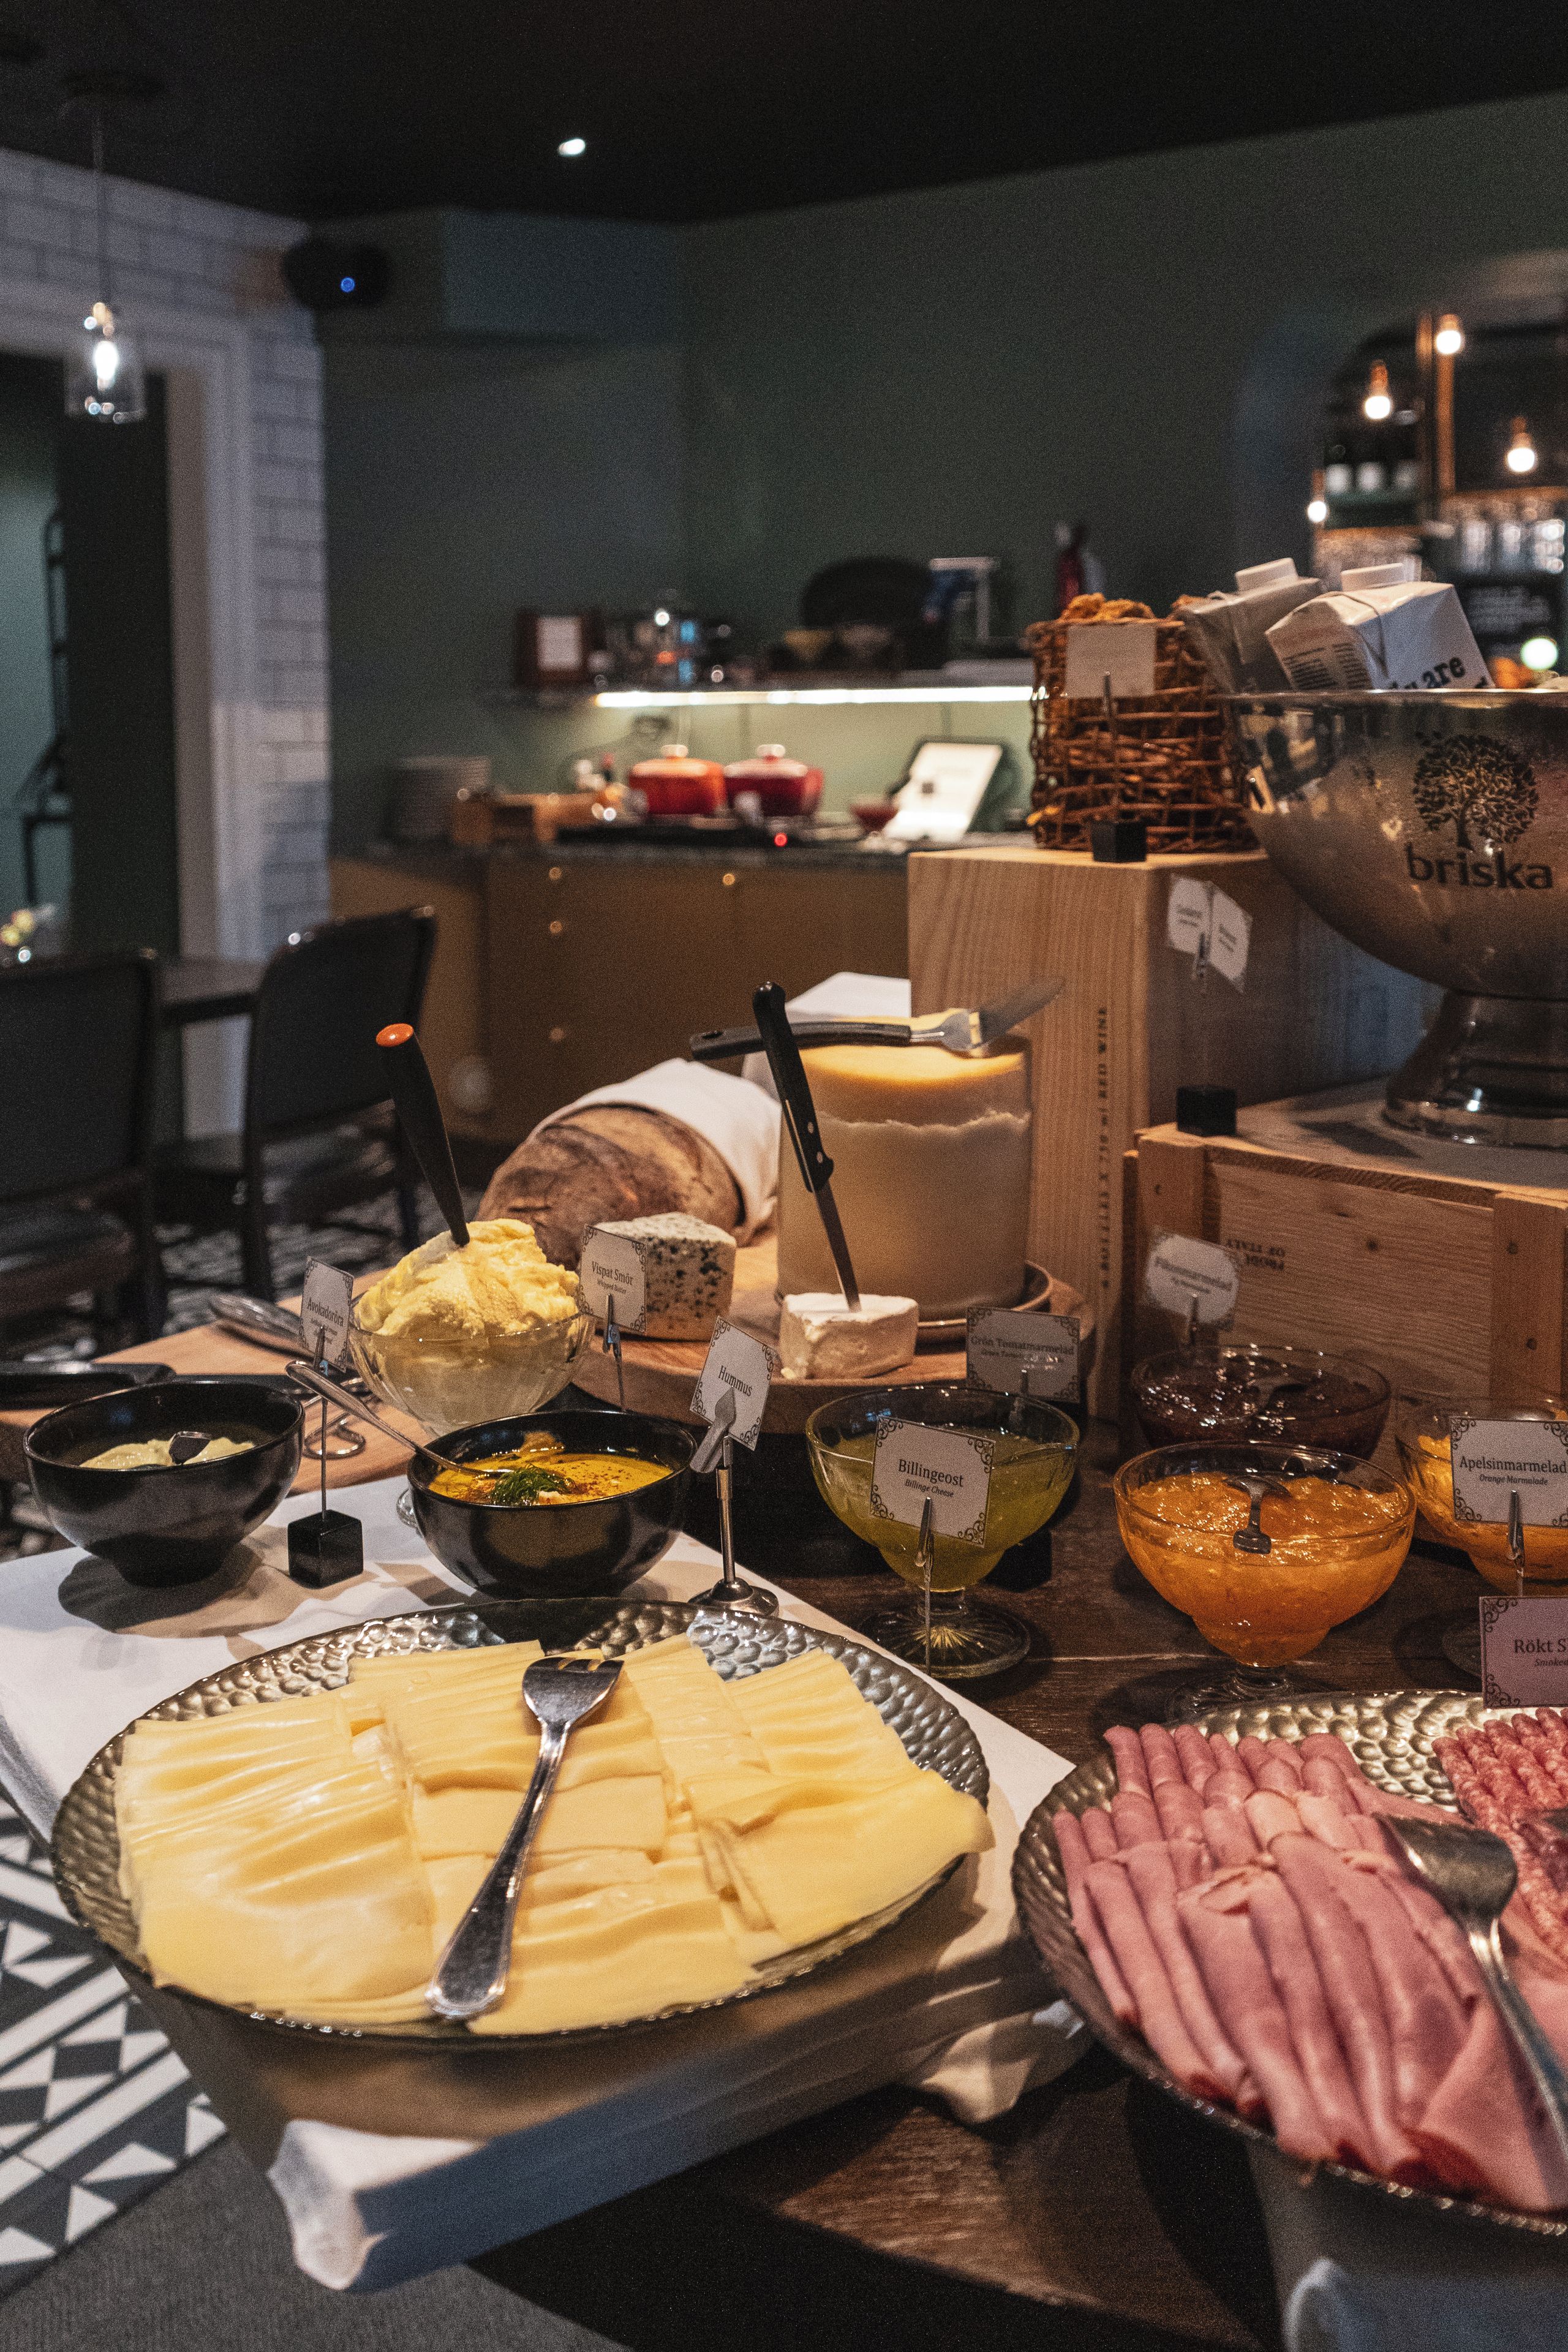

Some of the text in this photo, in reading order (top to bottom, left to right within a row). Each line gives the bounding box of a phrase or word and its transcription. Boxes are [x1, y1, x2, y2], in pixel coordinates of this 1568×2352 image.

[1404, 842, 1553, 889] briska
[1098, 1007, 1107, 1055] WINE
[592, 1261, 633, 1286] Vispat Smör
[307, 1297, 344, 1327] Avokadoröra
[718, 1365, 753, 1397] Hummus
[899, 1458, 964, 1488] Billingeost
[1460, 1455, 1567, 1474] Apelsinmarmelad
[905, 1479, 954, 1498] Billinge Cheese
[1479, 1474, 1548, 1486] Orange Marmalade
[1514, 1638, 1568, 1653] Rökt S
